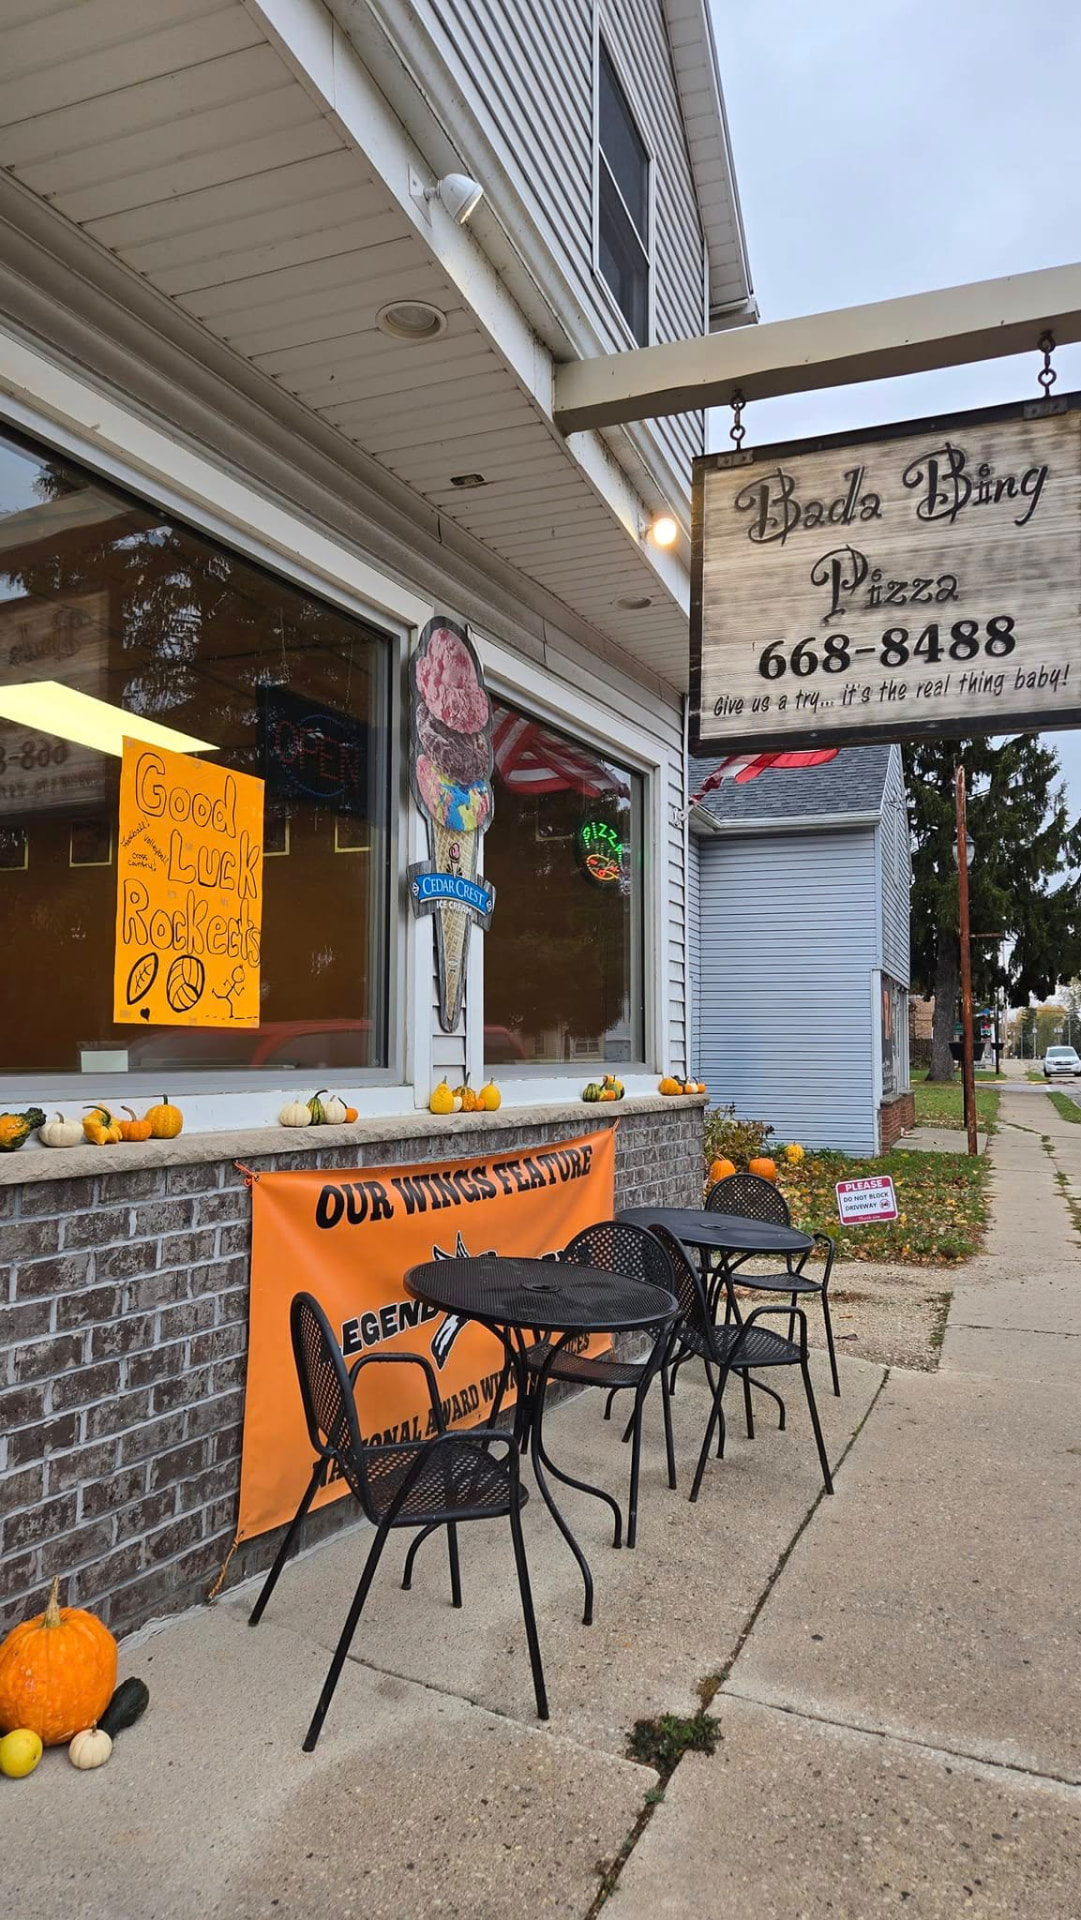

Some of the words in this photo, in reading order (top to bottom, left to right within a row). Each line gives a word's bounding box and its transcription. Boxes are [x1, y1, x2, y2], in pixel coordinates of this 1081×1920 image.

[734, 465, 882, 546] Bada
[902, 441, 1048, 527] Bing
[810, 544, 959, 626] Pizza
[758, 615, 1017, 680] 668-8488
[713, 694, 744, 716] Give
[752, 698, 770, 713] us
[778, 694, 788, 710] a
[796, 688, 833, 714] try...
[842, 683, 871, 706] it's
[878, 680, 907, 701] the
[916, 673, 950, 699] real
[959, 669, 1005, 697] thing
[1014, 663, 1070, 693] baby!
[134, 752, 237, 839] Good
[582, 821, 623, 866] PIZZA
[422, 877, 456, 895] CEDAR
[455, 880, 486, 907] CREST
[436, 900, 448, 909] ICE
[448, 901, 472, 916] CREAM
[315, 1181, 395, 1230] OUR
[391, 1165, 497, 1216] WINGS
[492, 1145, 593, 1195] FEATURE
[845, 1179, 883, 1191] PLEASE
[845, 1202, 877, 1211] DRIVEWAY
[339, 1299, 440, 1358] EGEND
